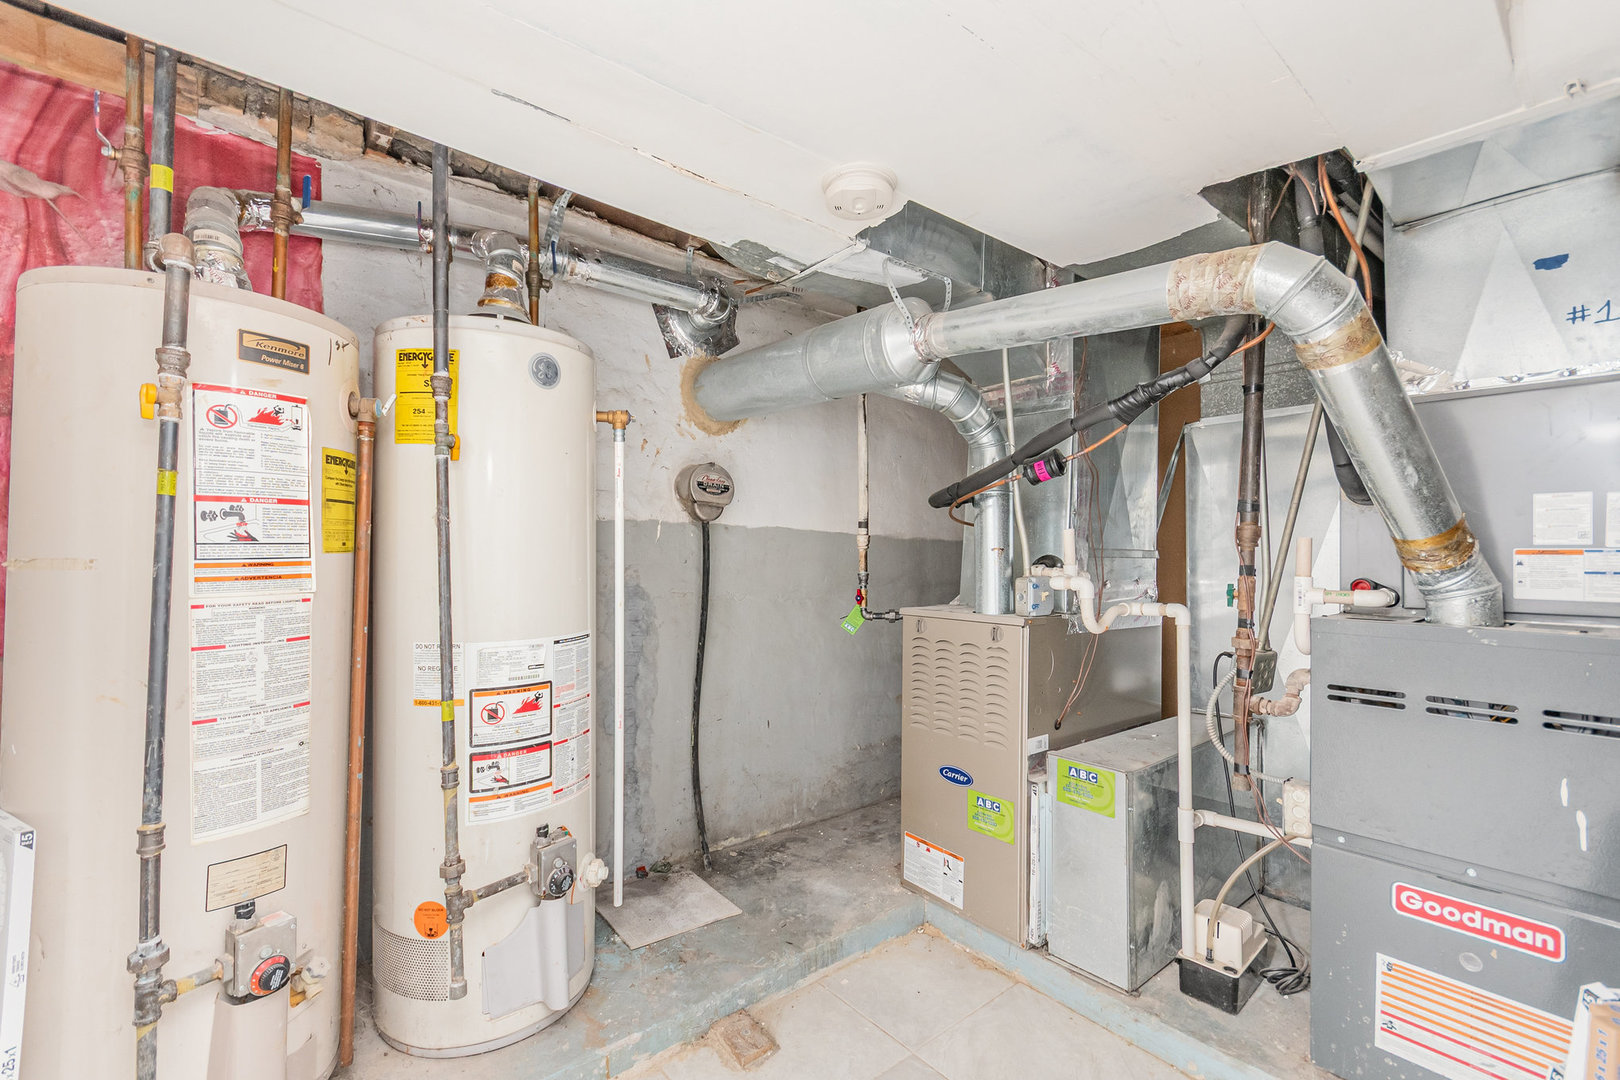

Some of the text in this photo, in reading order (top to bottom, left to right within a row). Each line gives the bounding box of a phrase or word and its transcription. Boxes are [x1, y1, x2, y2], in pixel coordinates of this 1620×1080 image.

[255, 341, 304, 358] Kenmore
[399, 352, 454, 361] ENERGYGE
[261, 355, 281, 366] Power
[249, 390, 277, 399] DANGER
[942, 768, 968, 783] Carrier
[1069, 766, 1098, 783] ABC
[504, 790, 529, 798] WARNING
[977, 797, 1001, 812] ABC
[1400, 891, 1555, 951] Goodman
